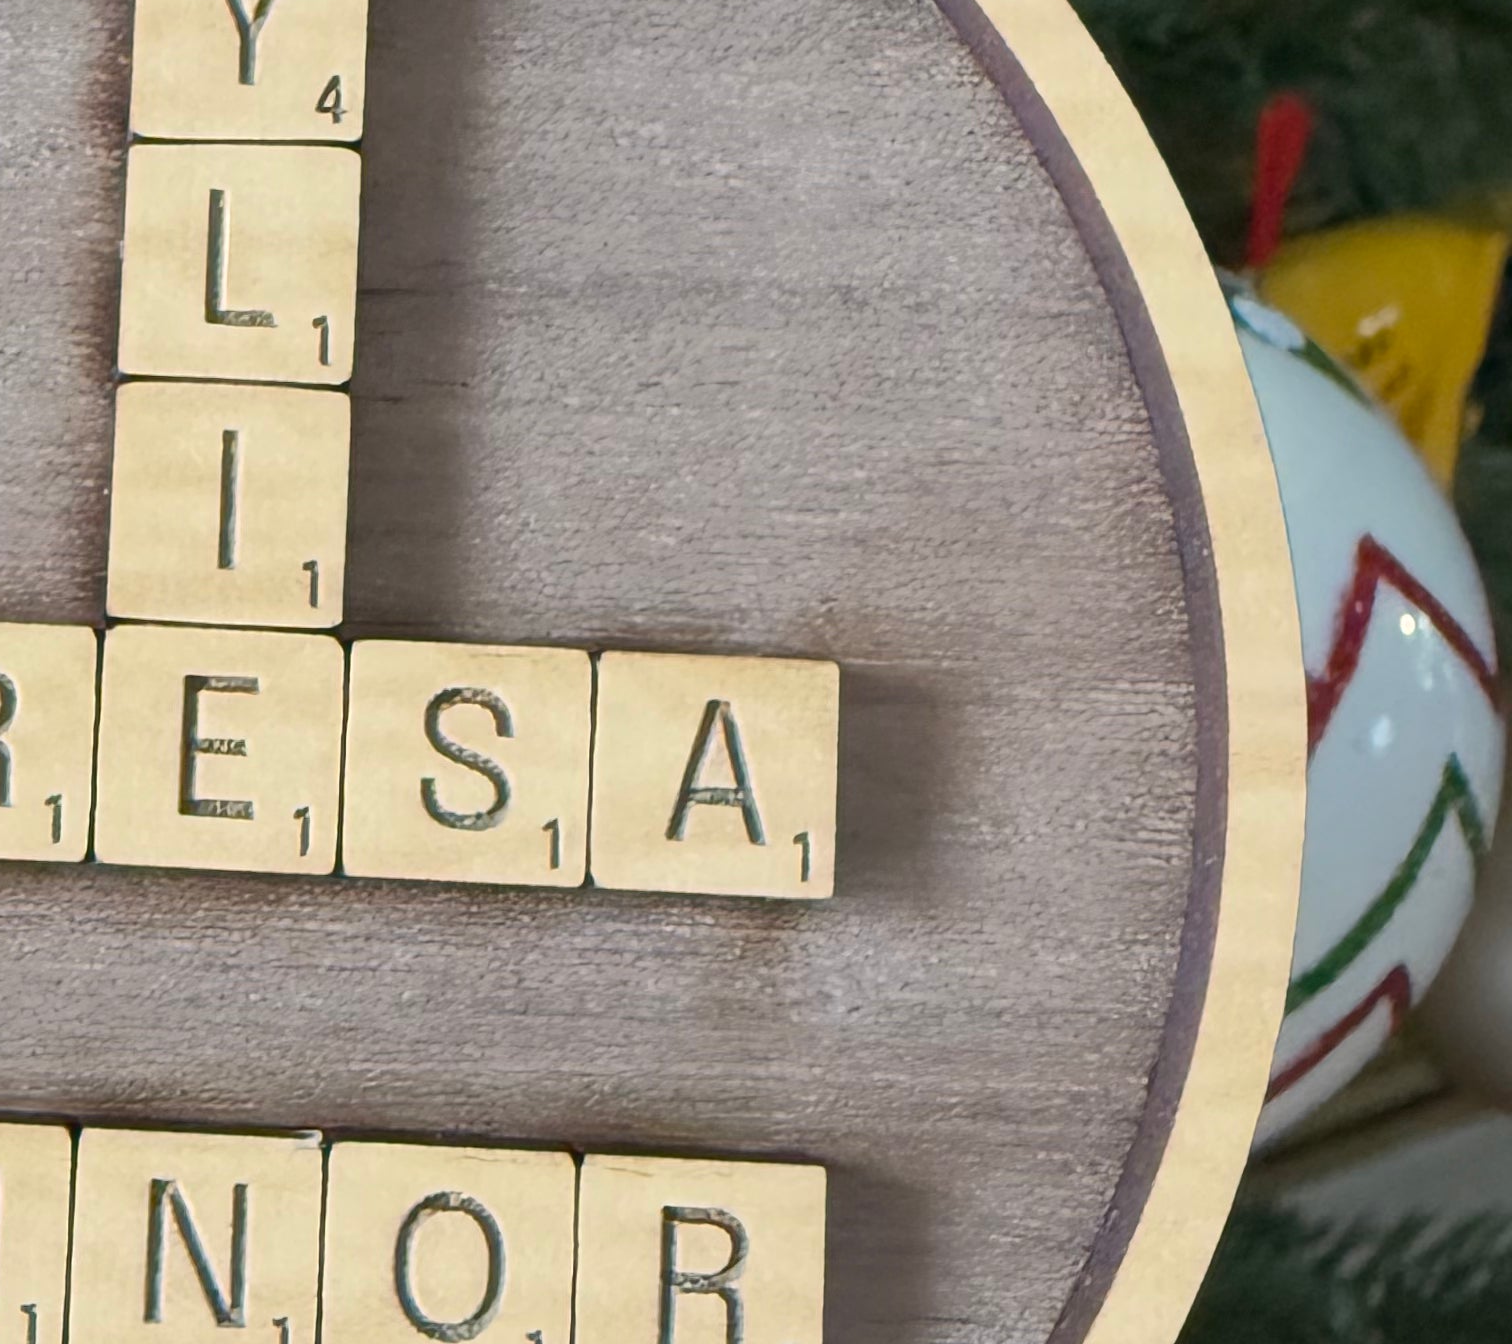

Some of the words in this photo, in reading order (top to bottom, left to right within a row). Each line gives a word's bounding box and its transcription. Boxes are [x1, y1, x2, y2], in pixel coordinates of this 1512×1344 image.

[313, 72, 348, 126] 4
[310, 314, 331, 368] 1
[300, 558, 321, 610] 1
[43, 792, 65, 845] 1
[292, 805, 313, 858] 1
[540, 816, 562, 870] 1
[790, 832, 812, 884] 1
